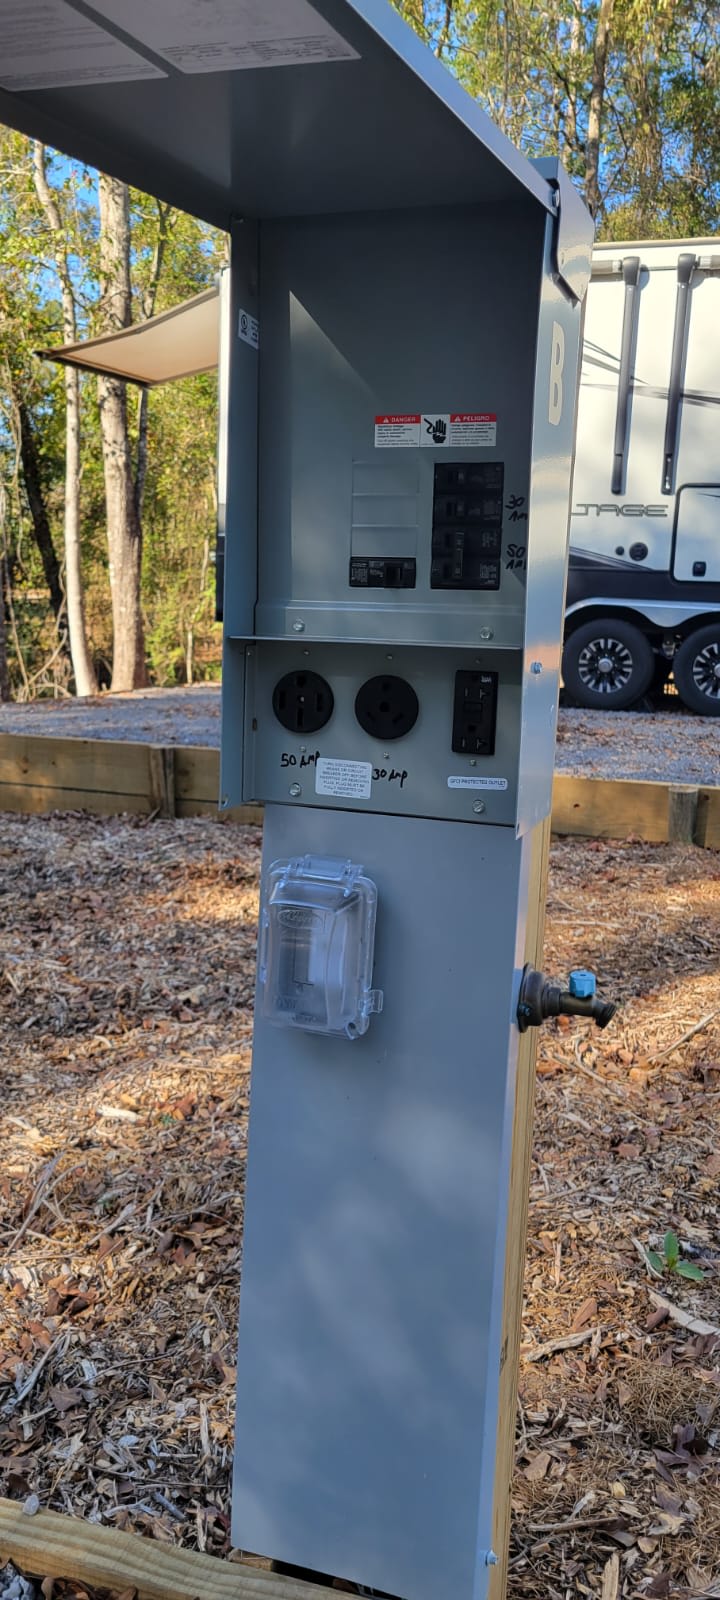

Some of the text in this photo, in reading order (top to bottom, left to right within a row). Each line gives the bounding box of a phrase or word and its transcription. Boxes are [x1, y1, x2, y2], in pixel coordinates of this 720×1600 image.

[548, 320, 565, 426] B
[505, 494, 525, 510] 30
[506, 543, 526, 559] 50
[280, 753, 297, 767] 50
[372, 768, 387, 781] 30
